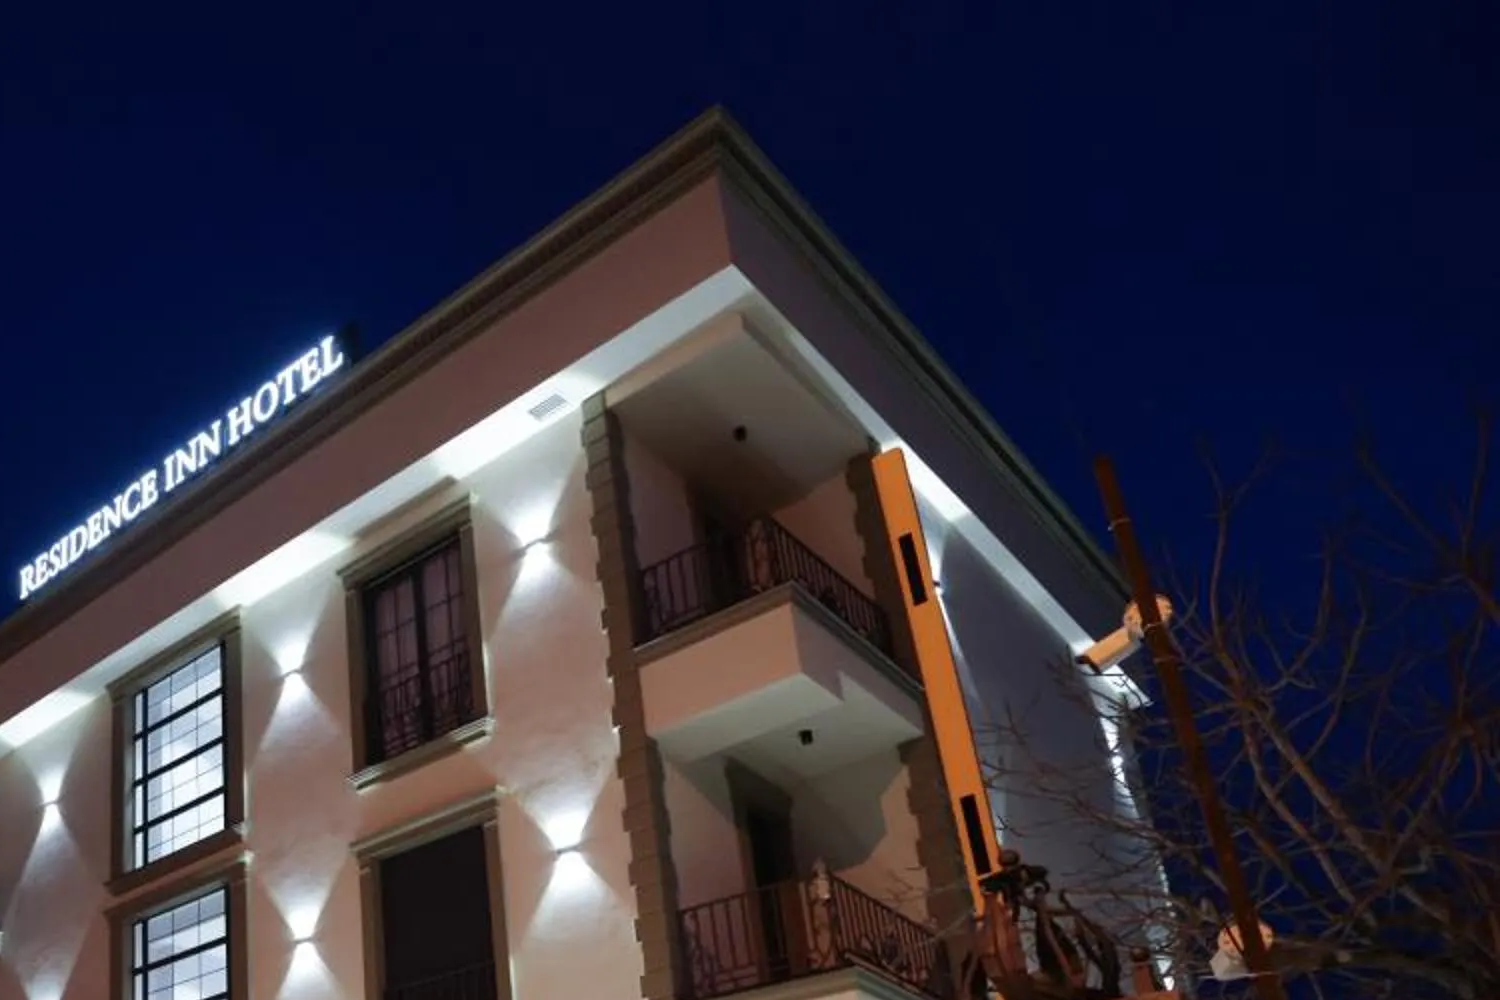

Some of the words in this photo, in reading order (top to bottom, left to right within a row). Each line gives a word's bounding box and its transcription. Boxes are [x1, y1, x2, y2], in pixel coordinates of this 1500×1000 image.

[18, 469, 159, 600] RESIDENCE
[163, 419, 222, 492] INN
[227, 335, 343, 445] HOTEL
